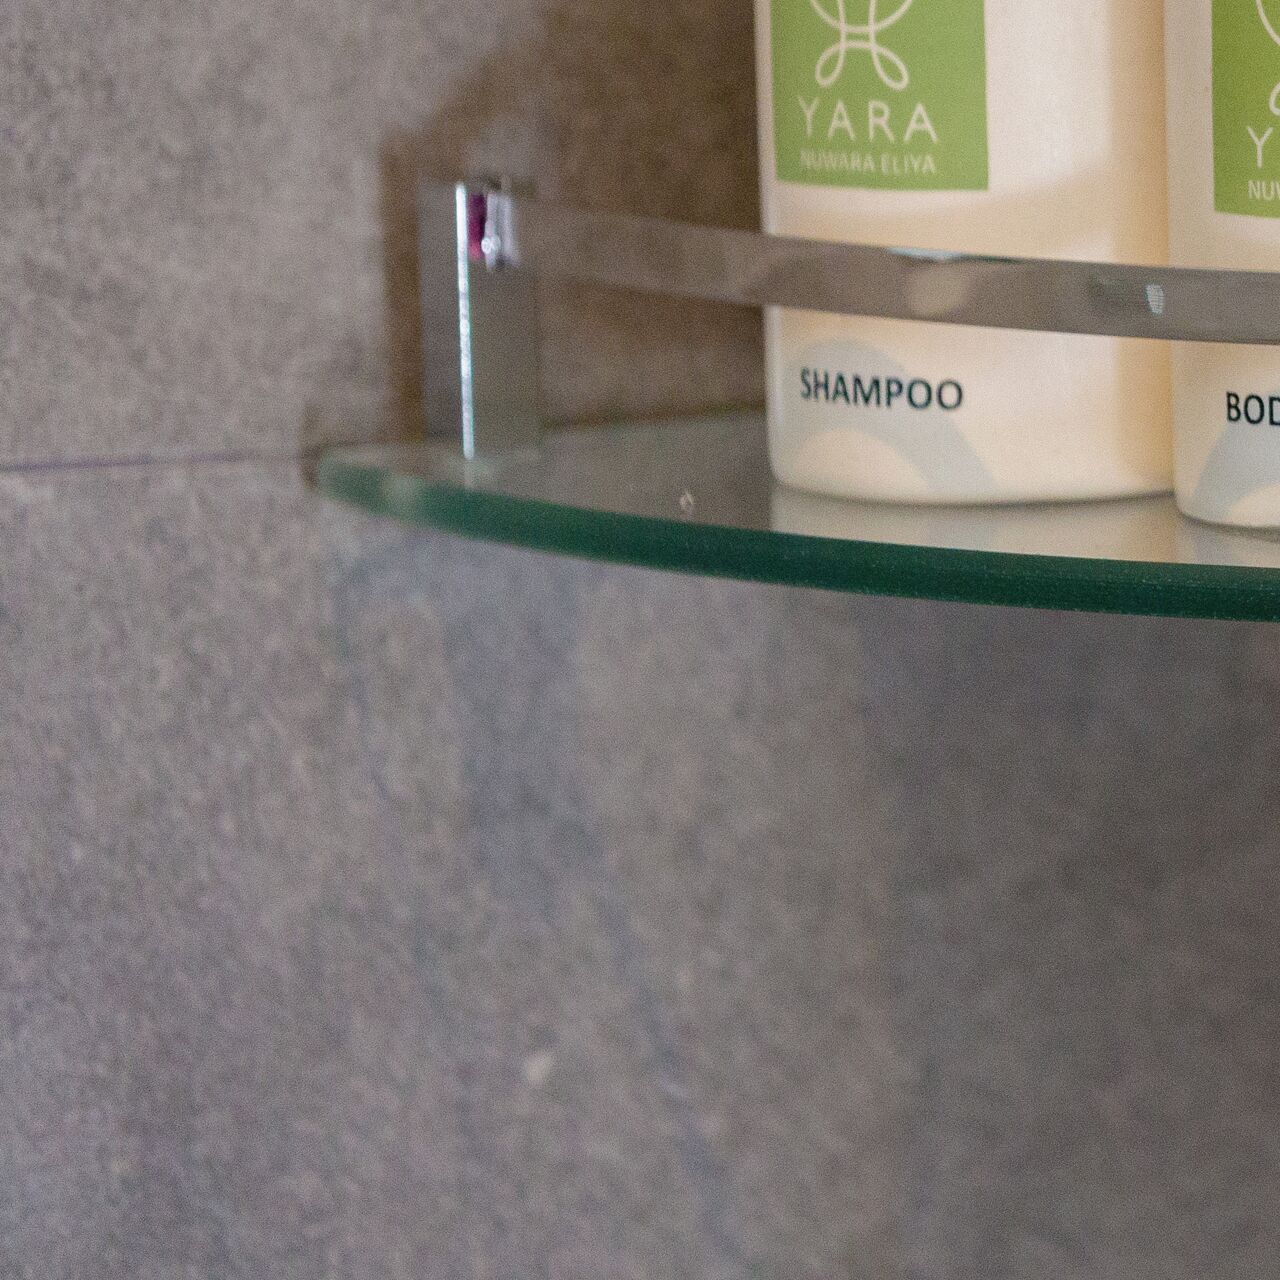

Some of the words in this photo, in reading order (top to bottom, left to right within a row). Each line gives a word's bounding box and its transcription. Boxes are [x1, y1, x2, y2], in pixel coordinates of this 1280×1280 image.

[798, 97, 939, 145] YARA
[800, 148, 875, 172] NUWARA
[881, 153, 937, 175] ELIYA
[800, 367, 963, 411] SHAMPOO
